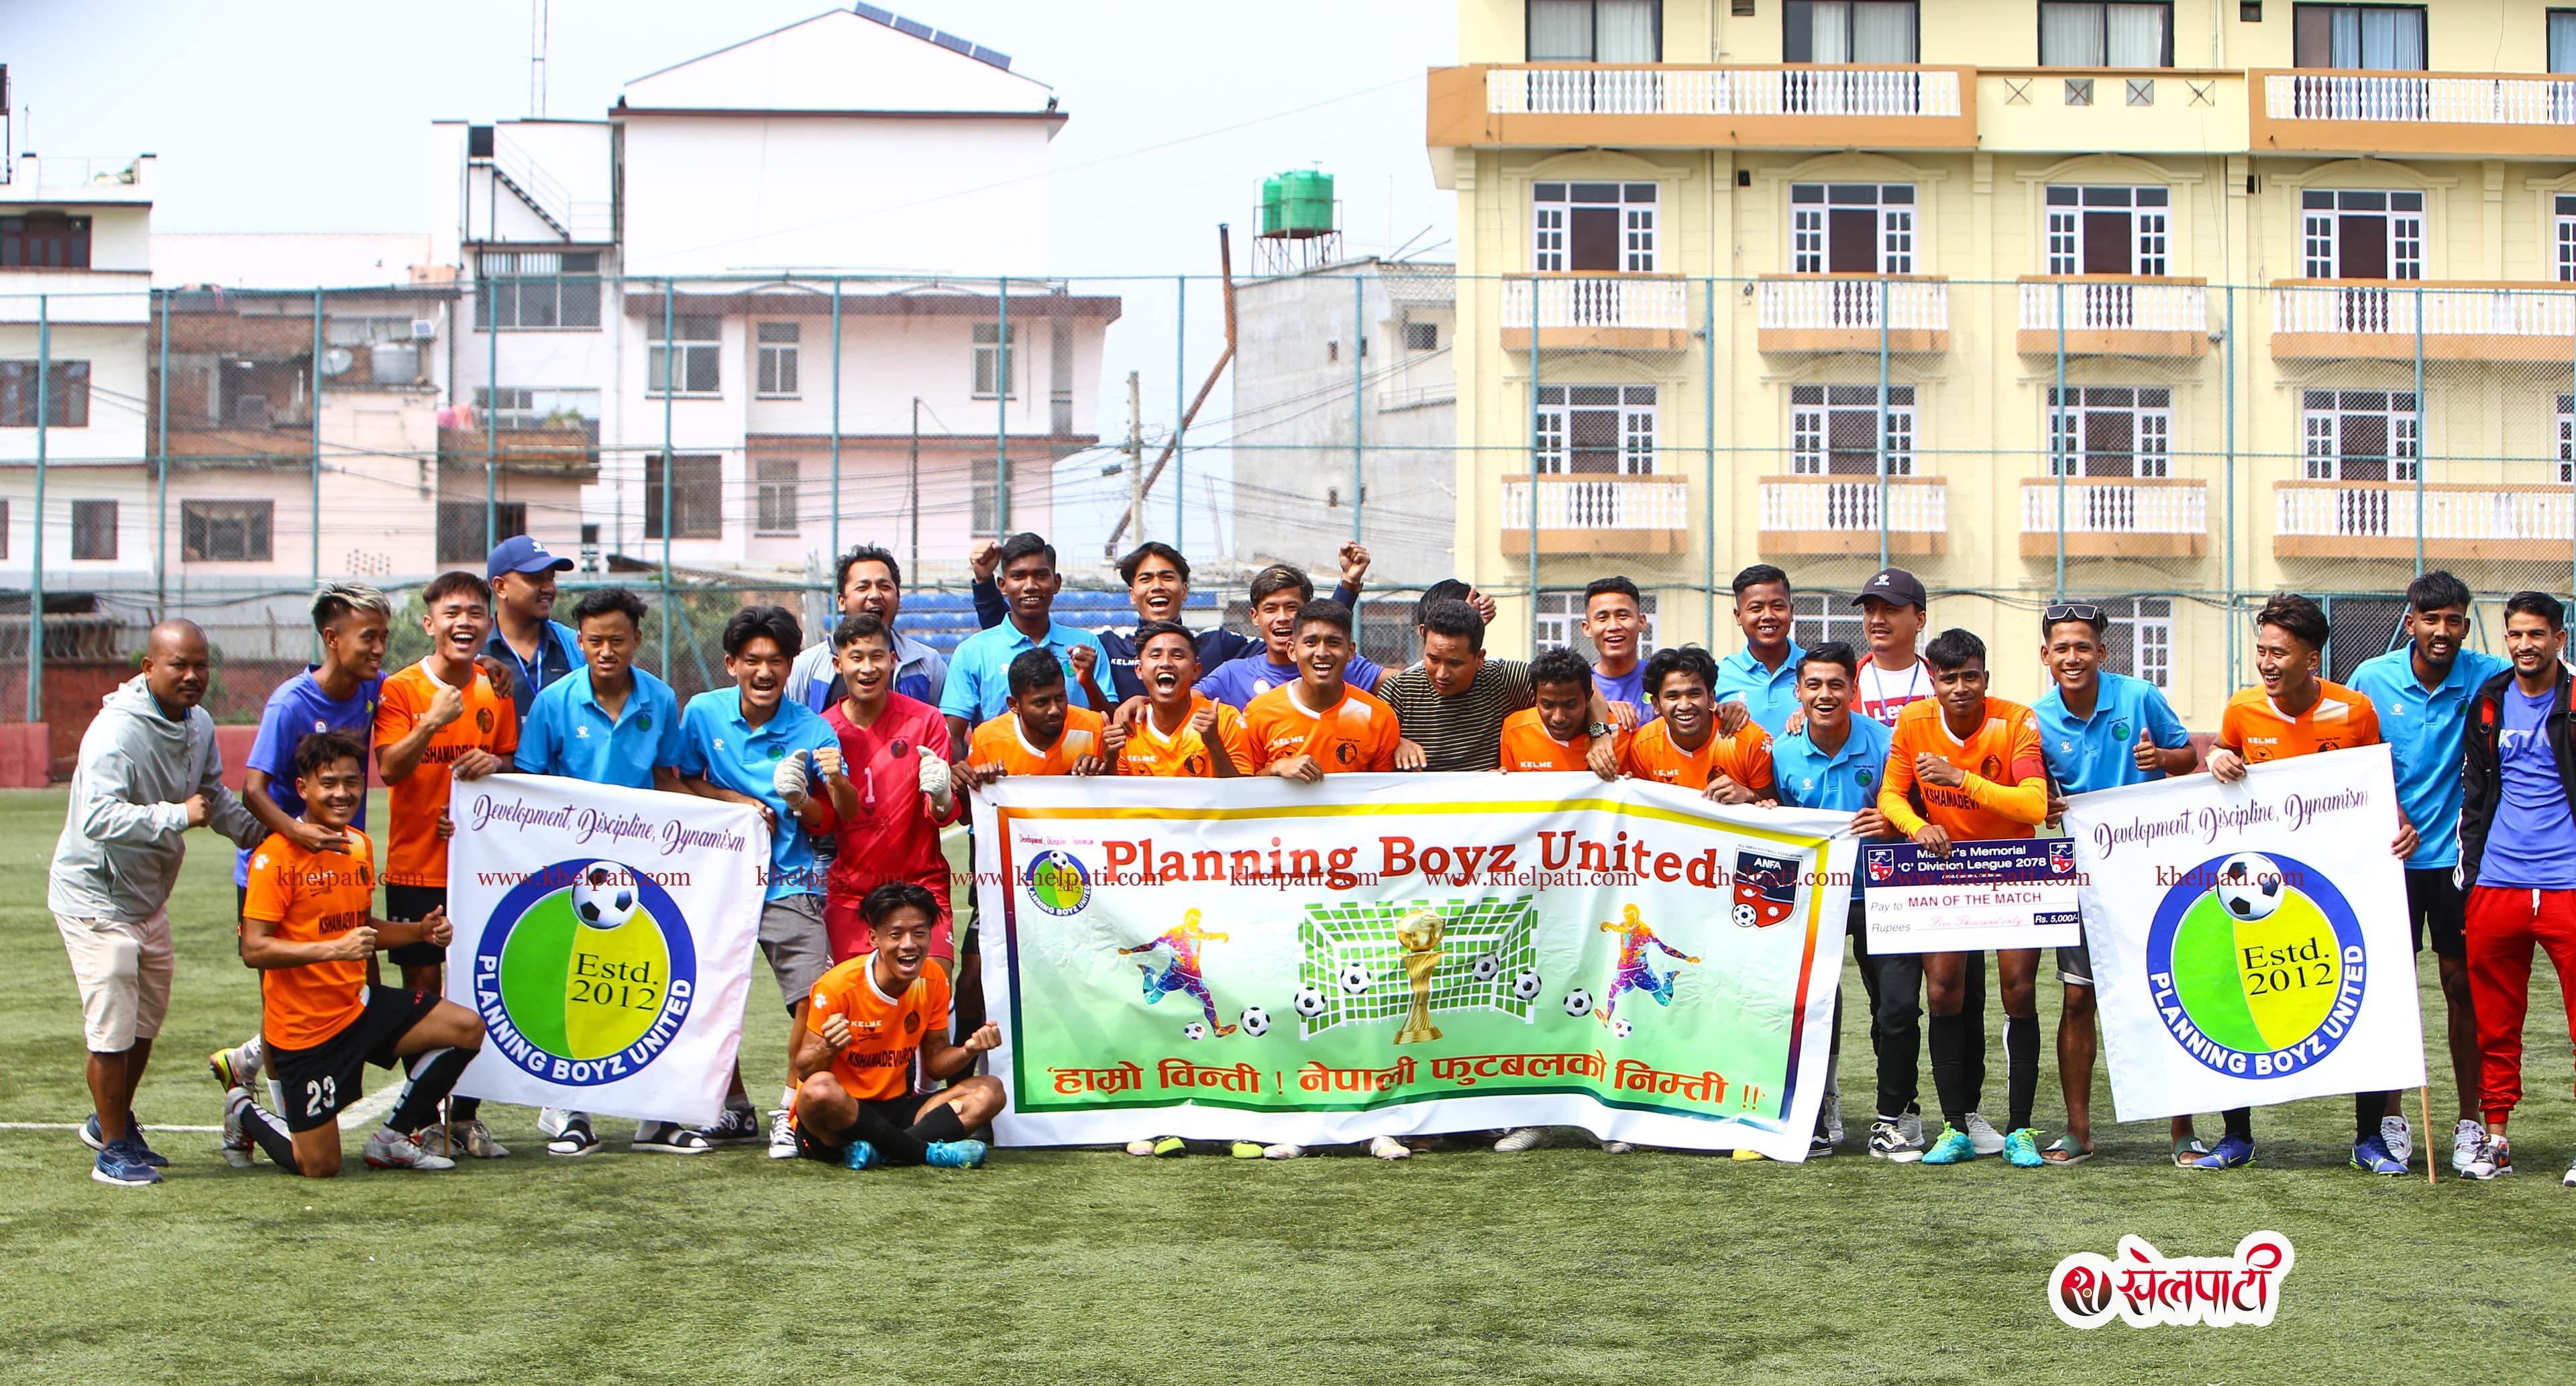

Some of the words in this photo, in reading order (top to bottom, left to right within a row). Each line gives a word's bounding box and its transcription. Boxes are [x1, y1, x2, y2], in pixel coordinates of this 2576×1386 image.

[1273, 735, 1305, 746] KELME
[2247, 737, 2278, 745] KELME
[1127, 754, 1157, 762] KELME
[864, 767, 875, 804] 1
[471, 794, 576, 832] Development,
[576, 807, 655, 845] Discipline,
[659, 819, 745, 856] Dynamism
[2094, 808, 2194, 860] Development,
[2199, 799, 2279, 845] Discipline,
[2284, 787, 2369, 832] Dynamism
[1102, 836, 1358, 890] Planning
[1379, 836, 1517, 887] Boyz
[1537, 830, 1717, 890] United
[1754, 857, 1782, 870] ANFA
[1918, 860, 1964, 871] Division
[1967, 859, 2012, 871] League
[2015, 857, 2047, 867] 2078
[1970, 845, 2026, 857] Memorial
[1056, 907, 1079, 916] BOYZ
[1871, 902, 1891, 912] Pay
[1893, 902, 1902, 911] to
[1909, 896, 1938, 908] MAN
[1943, 895, 1961, 906] OF
[1964, 894, 1991, 906] THE
[1995, 892, 2041, 904] MATCH
[1872, 922, 1911, 933] Rupees
[2035, 914, 2048, 924] Rs.
[2050, 913, 2078, 924] 5,000/-
[575, 952, 659, 985] Estd.
[2240, 937, 2330, 971] Estd.
[570, 979, 657, 1010] 2012
[2247, 963, 2334, 996] 2012
[476, 955, 547, 1071] PLANNING
[551, 1055, 627, 1082] BOYZ
[628, 979, 692, 1065] UNITED
[851, 1020, 883, 1028] KELME
[2150, 971, 2247, 1074] PLANNING
[2254, 1034, 2327, 1076] BOYZ
[2321, 945, 2364, 1039] UNITED
[1157, 1057, 1262, 1094] विन्ती
[1297, 1055, 1418, 1094] नेपाली
[1430, 1049, 1607, 1086] फुटबलको
[1614, 1058, 1729, 1104] निम्ती
[306, 1075, 336, 1117] 23
